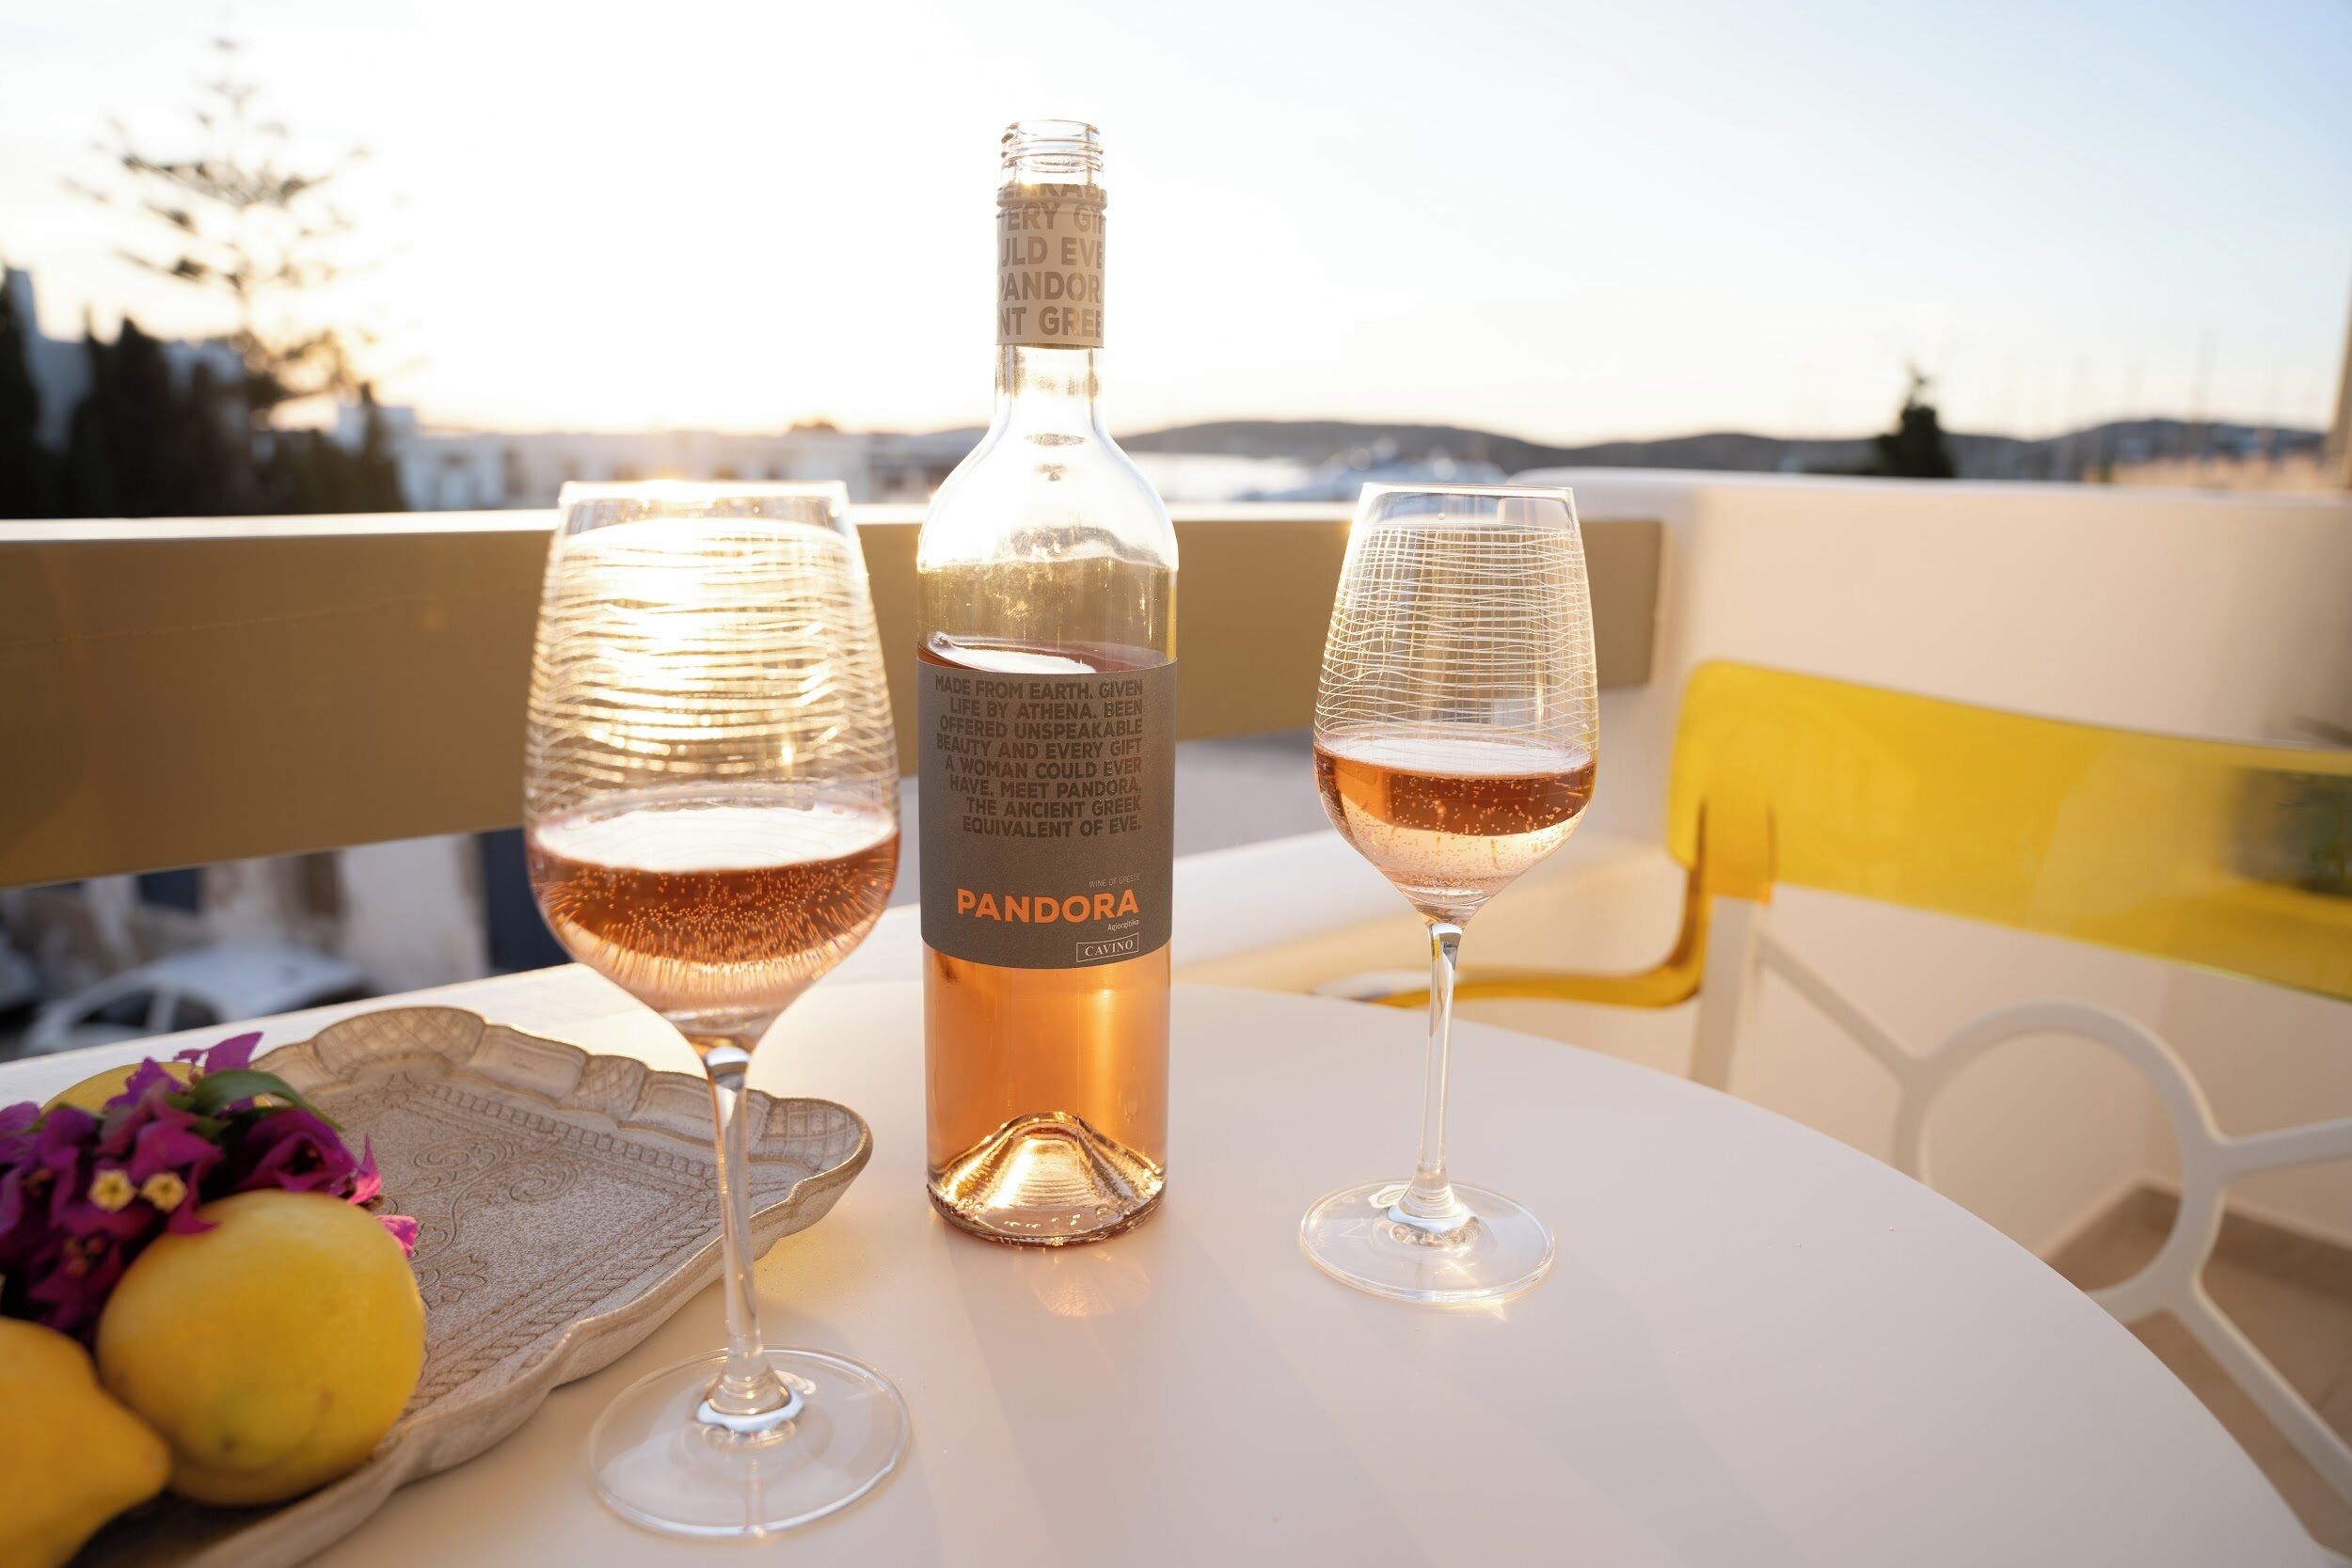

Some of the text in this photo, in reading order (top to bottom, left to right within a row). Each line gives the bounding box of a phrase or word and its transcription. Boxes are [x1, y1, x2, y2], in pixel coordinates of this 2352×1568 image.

[1000, 203, 1061, 231] ERY
[935, 674, 1143, 700] MADE FROM EARTH. GIVEN
[950, 698, 1143, 720] LIFE BY ATHENA. BEEN
[940, 715, 1143, 740] OFFERED UNSPEAKABLE
[936, 733, 1143, 760] BEAUTY AND EVERY GIFT
[945, 755, 1142, 780] A WOMAN COULD EVER
[949, 775, 1142, 799] HAVE. MEET PANDORA,
[965, 795, 1142, 819] THE ANCIENT GREEK
[962, 815, 1141, 838] EQUIVALENT OF EVE.
[1089, 873, 1140, 888] WINE OF GREECE
[957, 888, 1139, 924] PANDORA
[1085, 939, 1134, 958] CAVINO
